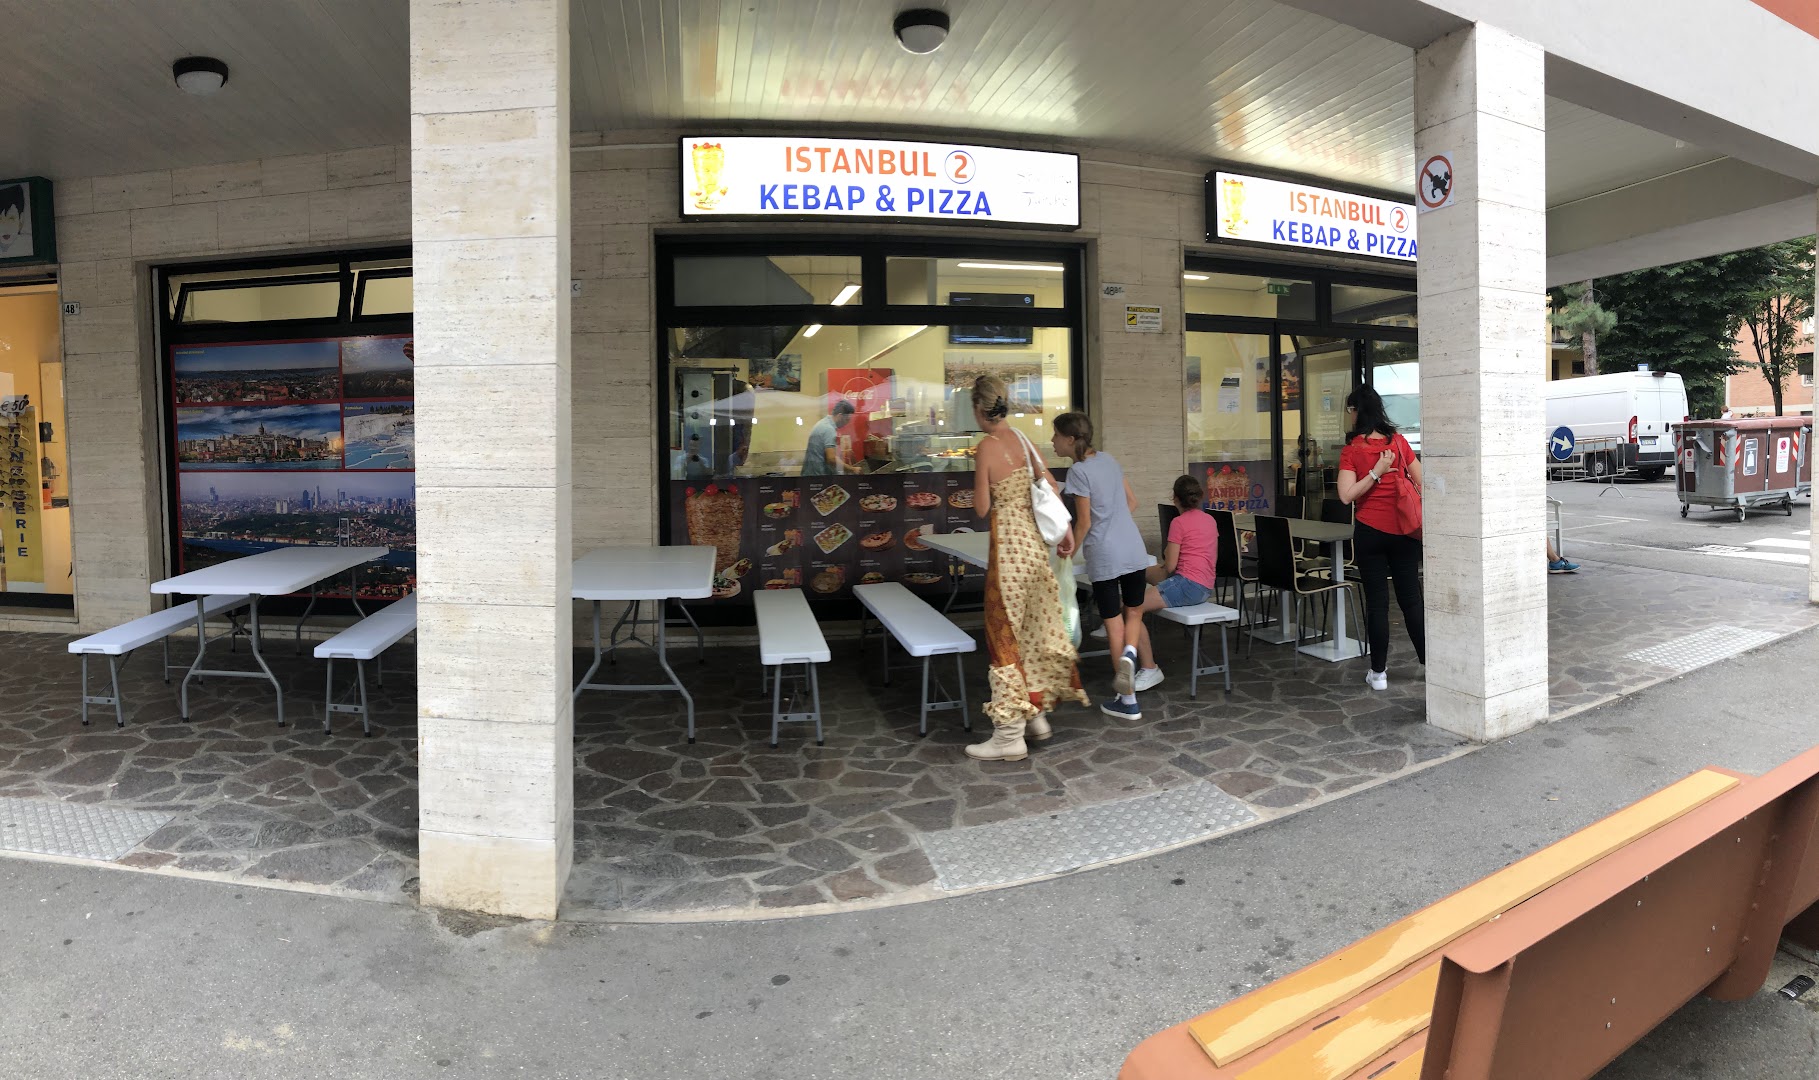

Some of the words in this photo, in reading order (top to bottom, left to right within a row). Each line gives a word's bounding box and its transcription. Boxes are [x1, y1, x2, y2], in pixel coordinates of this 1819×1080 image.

[785, 146, 937, 177] ISTANBUL
[954, 154, 968, 179] 2
[760, 183, 866, 211] KEBAP
[875, 184, 896, 212] &
[907, 187, 992, 216] PIZZA
[1289, 191, 1386, 227] ISTANBUL
[1395, 210, 1405, 229] 2
[1272, 219, 1341, 248] KEBAP
[1347, 228, 1361, 251] &
[1366, 232, 1418, 259] PIZZA
[1208, 486, 1250, 499] TANBUL
[1238, 498, 1270, 511] PIZZA
